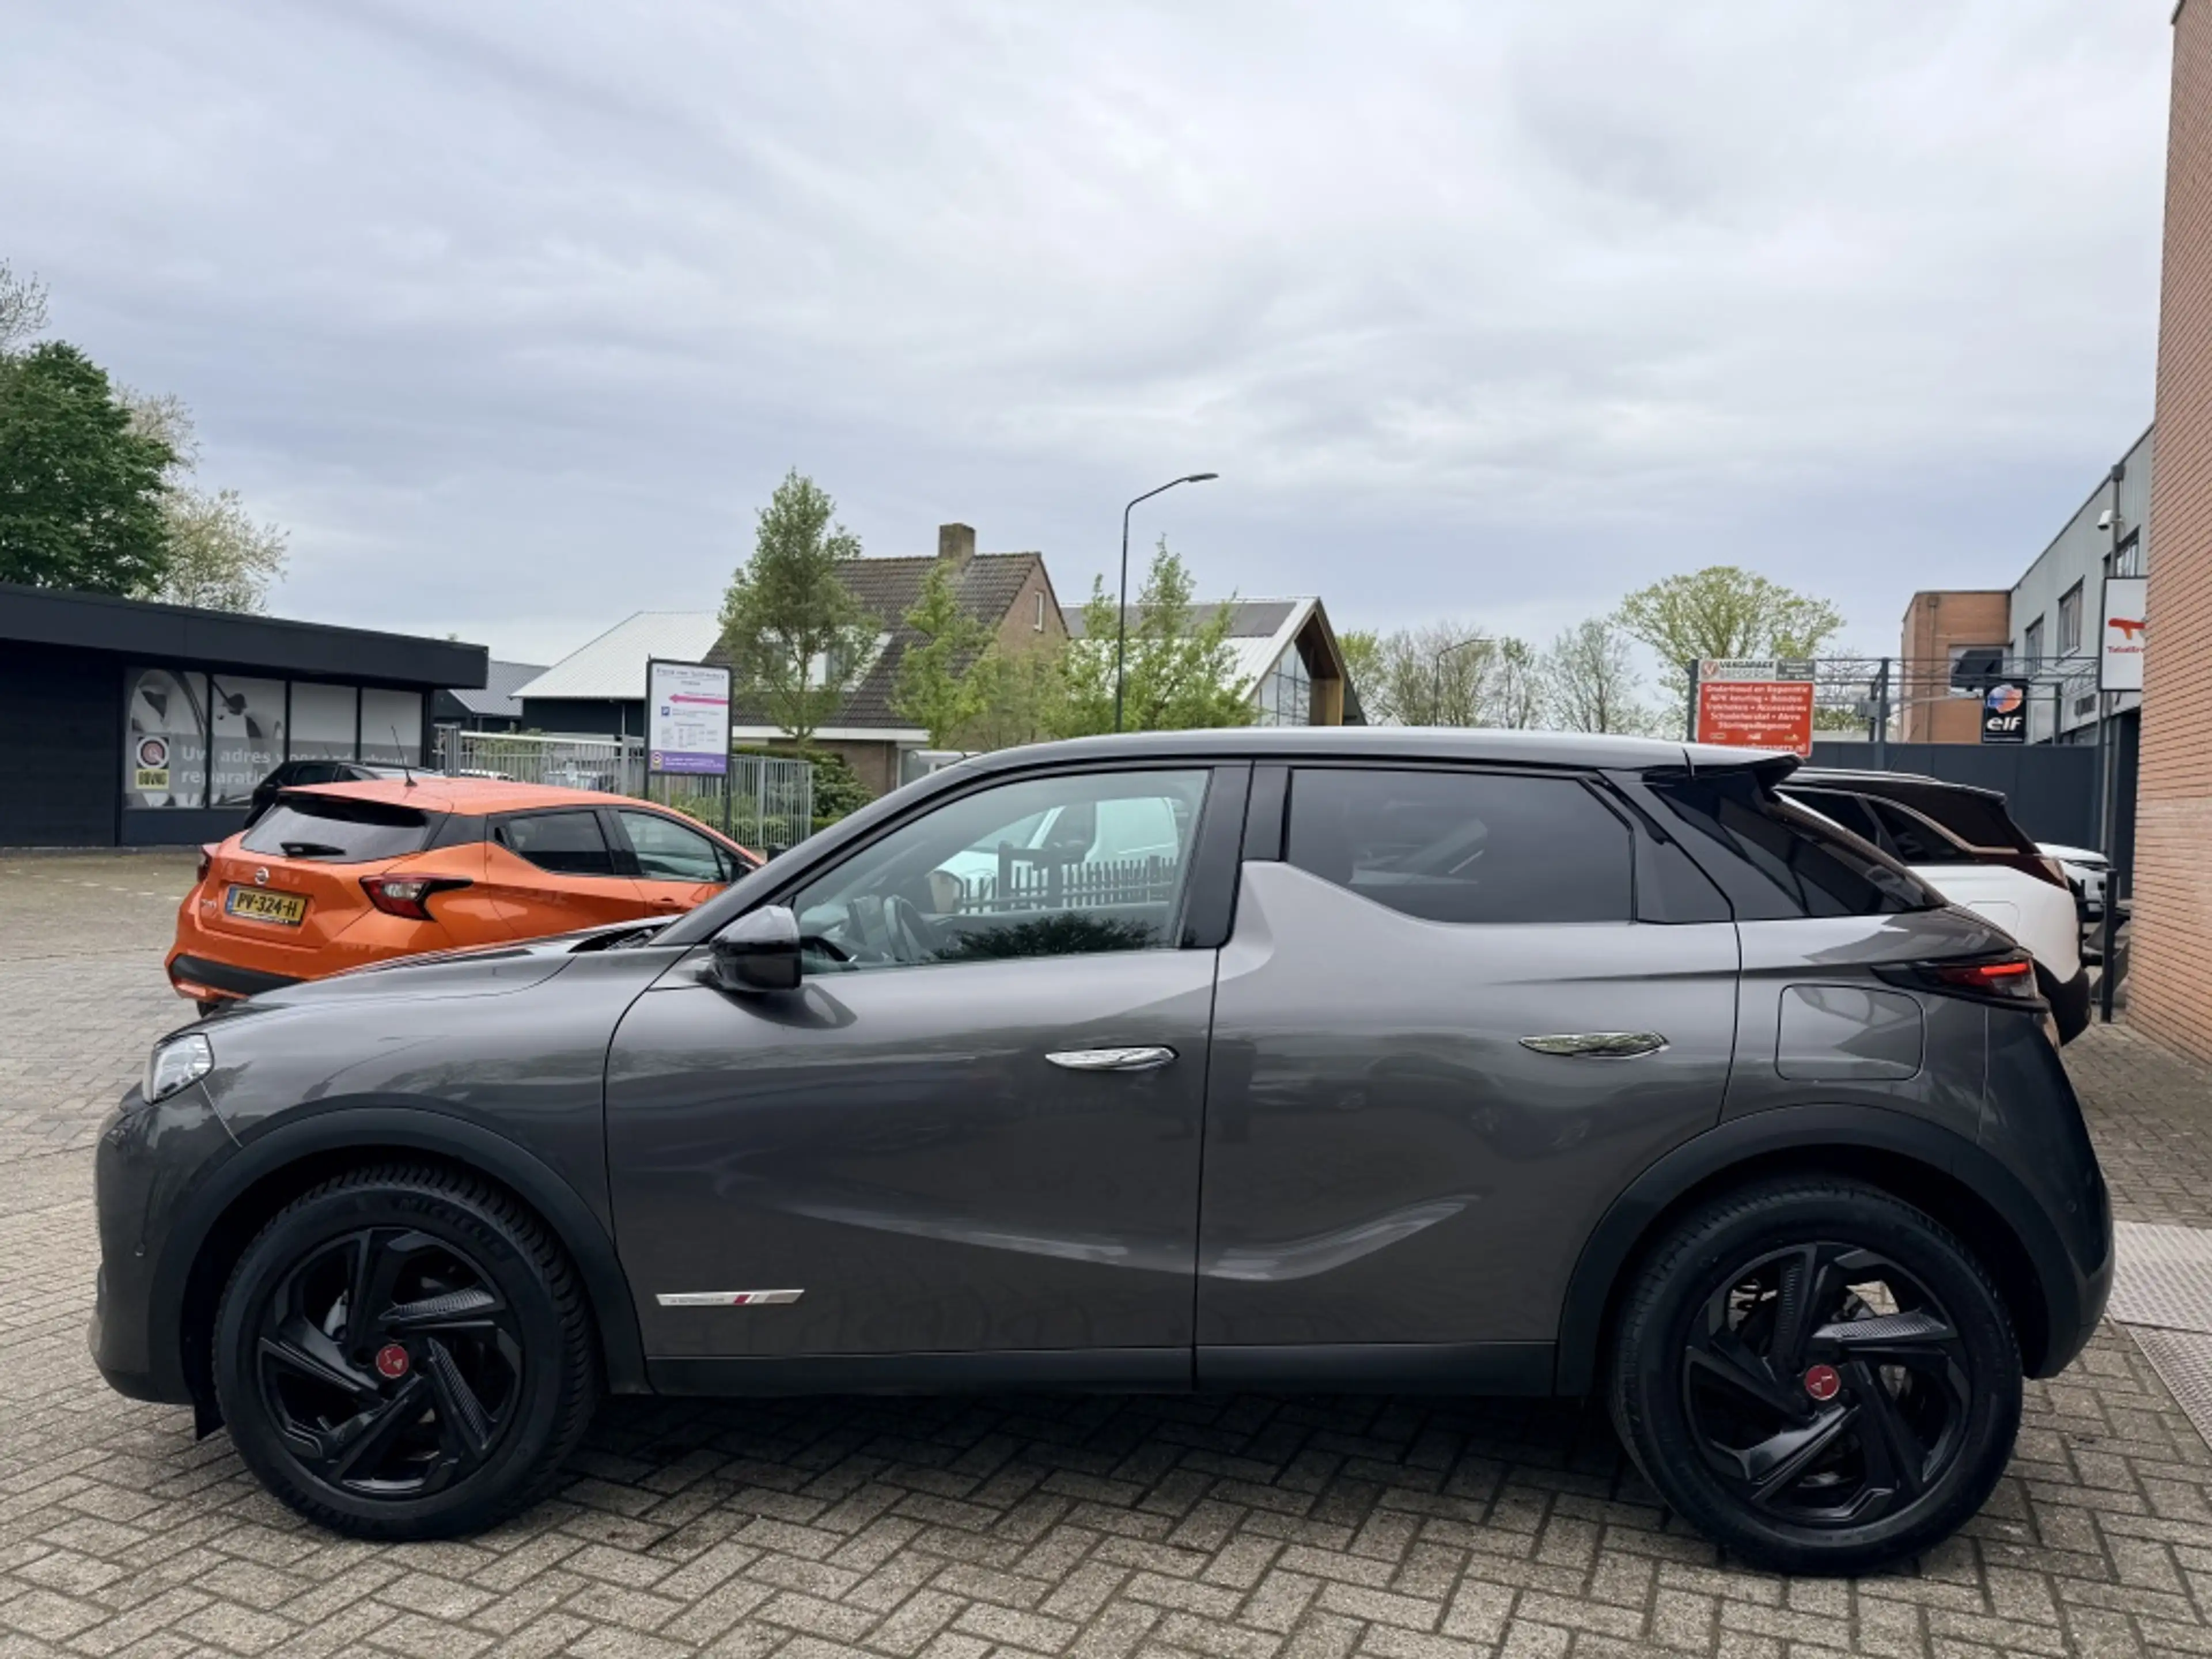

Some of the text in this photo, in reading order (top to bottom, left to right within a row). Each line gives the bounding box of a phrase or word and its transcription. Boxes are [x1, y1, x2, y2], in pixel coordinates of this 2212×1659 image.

[1986, 714, 2022, 731] elf
[220, 748, 271, 764] adres
[236, 892, 298, 917] PV-324-H
